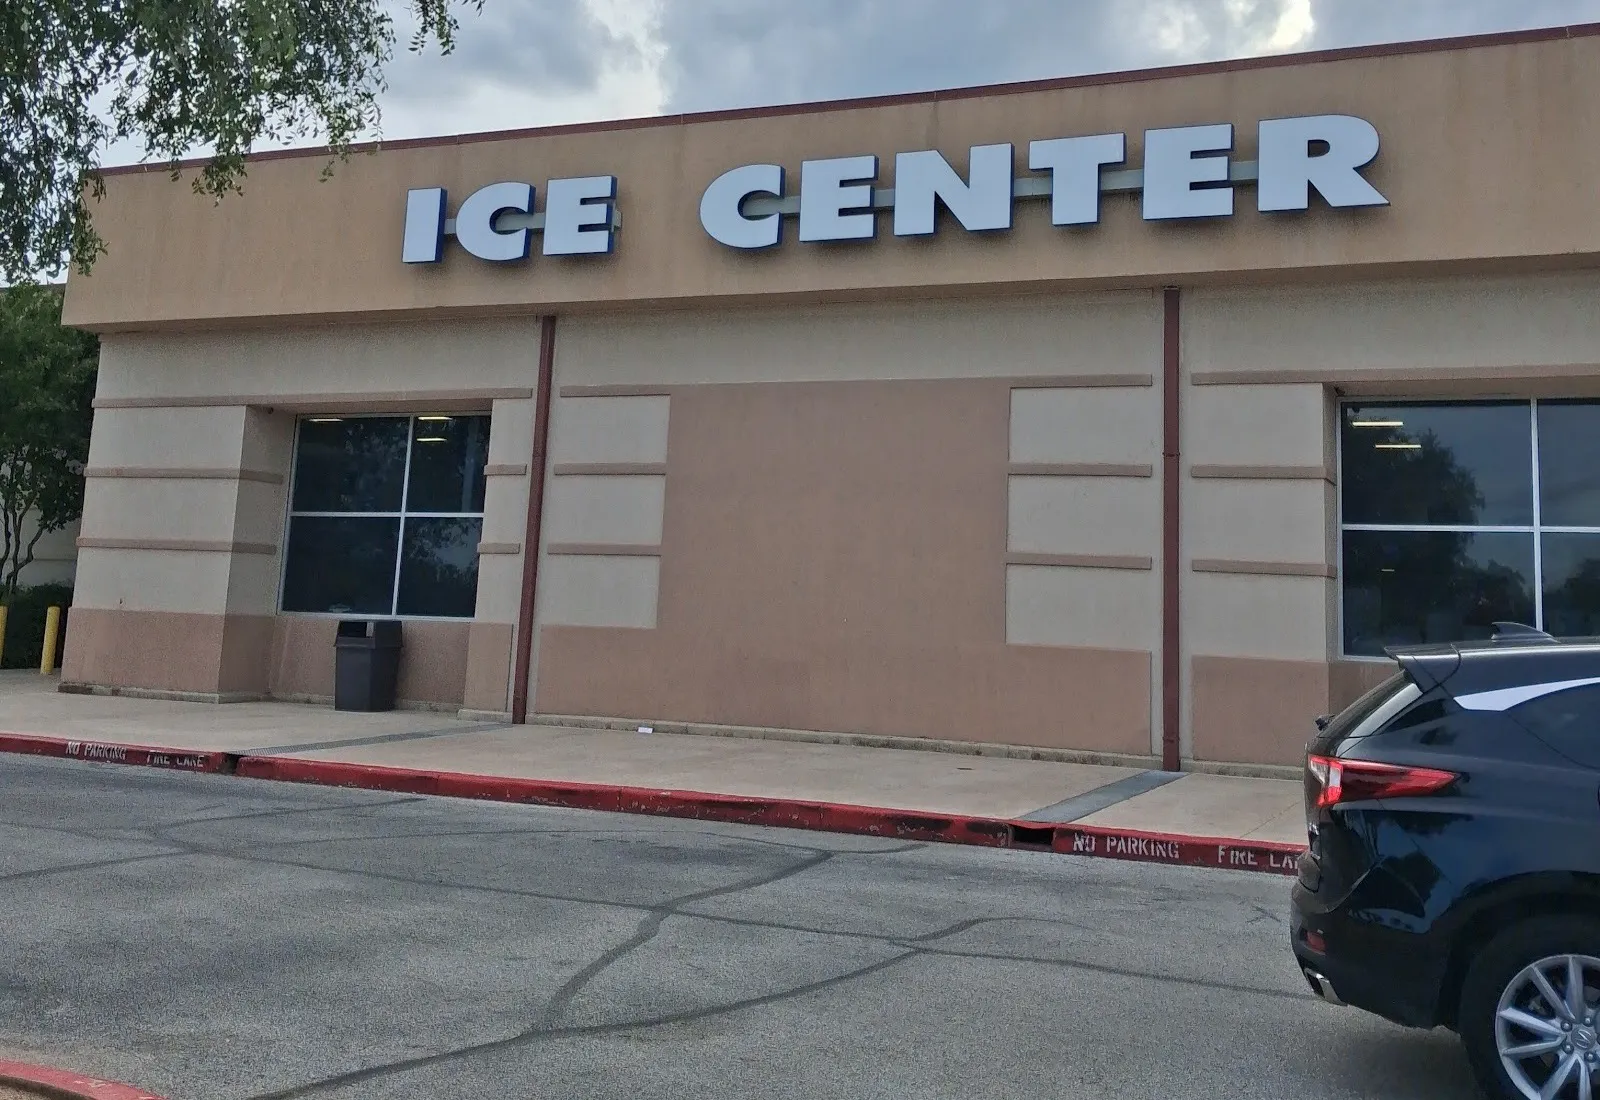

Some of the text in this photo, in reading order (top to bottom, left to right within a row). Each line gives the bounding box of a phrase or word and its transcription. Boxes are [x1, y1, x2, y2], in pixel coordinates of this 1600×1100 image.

[402, 113, 1390, 264] ICE CENTER
[65, 741, 82, 755] NO
[84, 743, 127, 760] PARKING
[176, 755, 205, 768] LANE
[1073, 832, 1097, 852] NO
[1106, 836, 1180, 858] PARKING
[1218, 845, 1258, 866] FIRE
